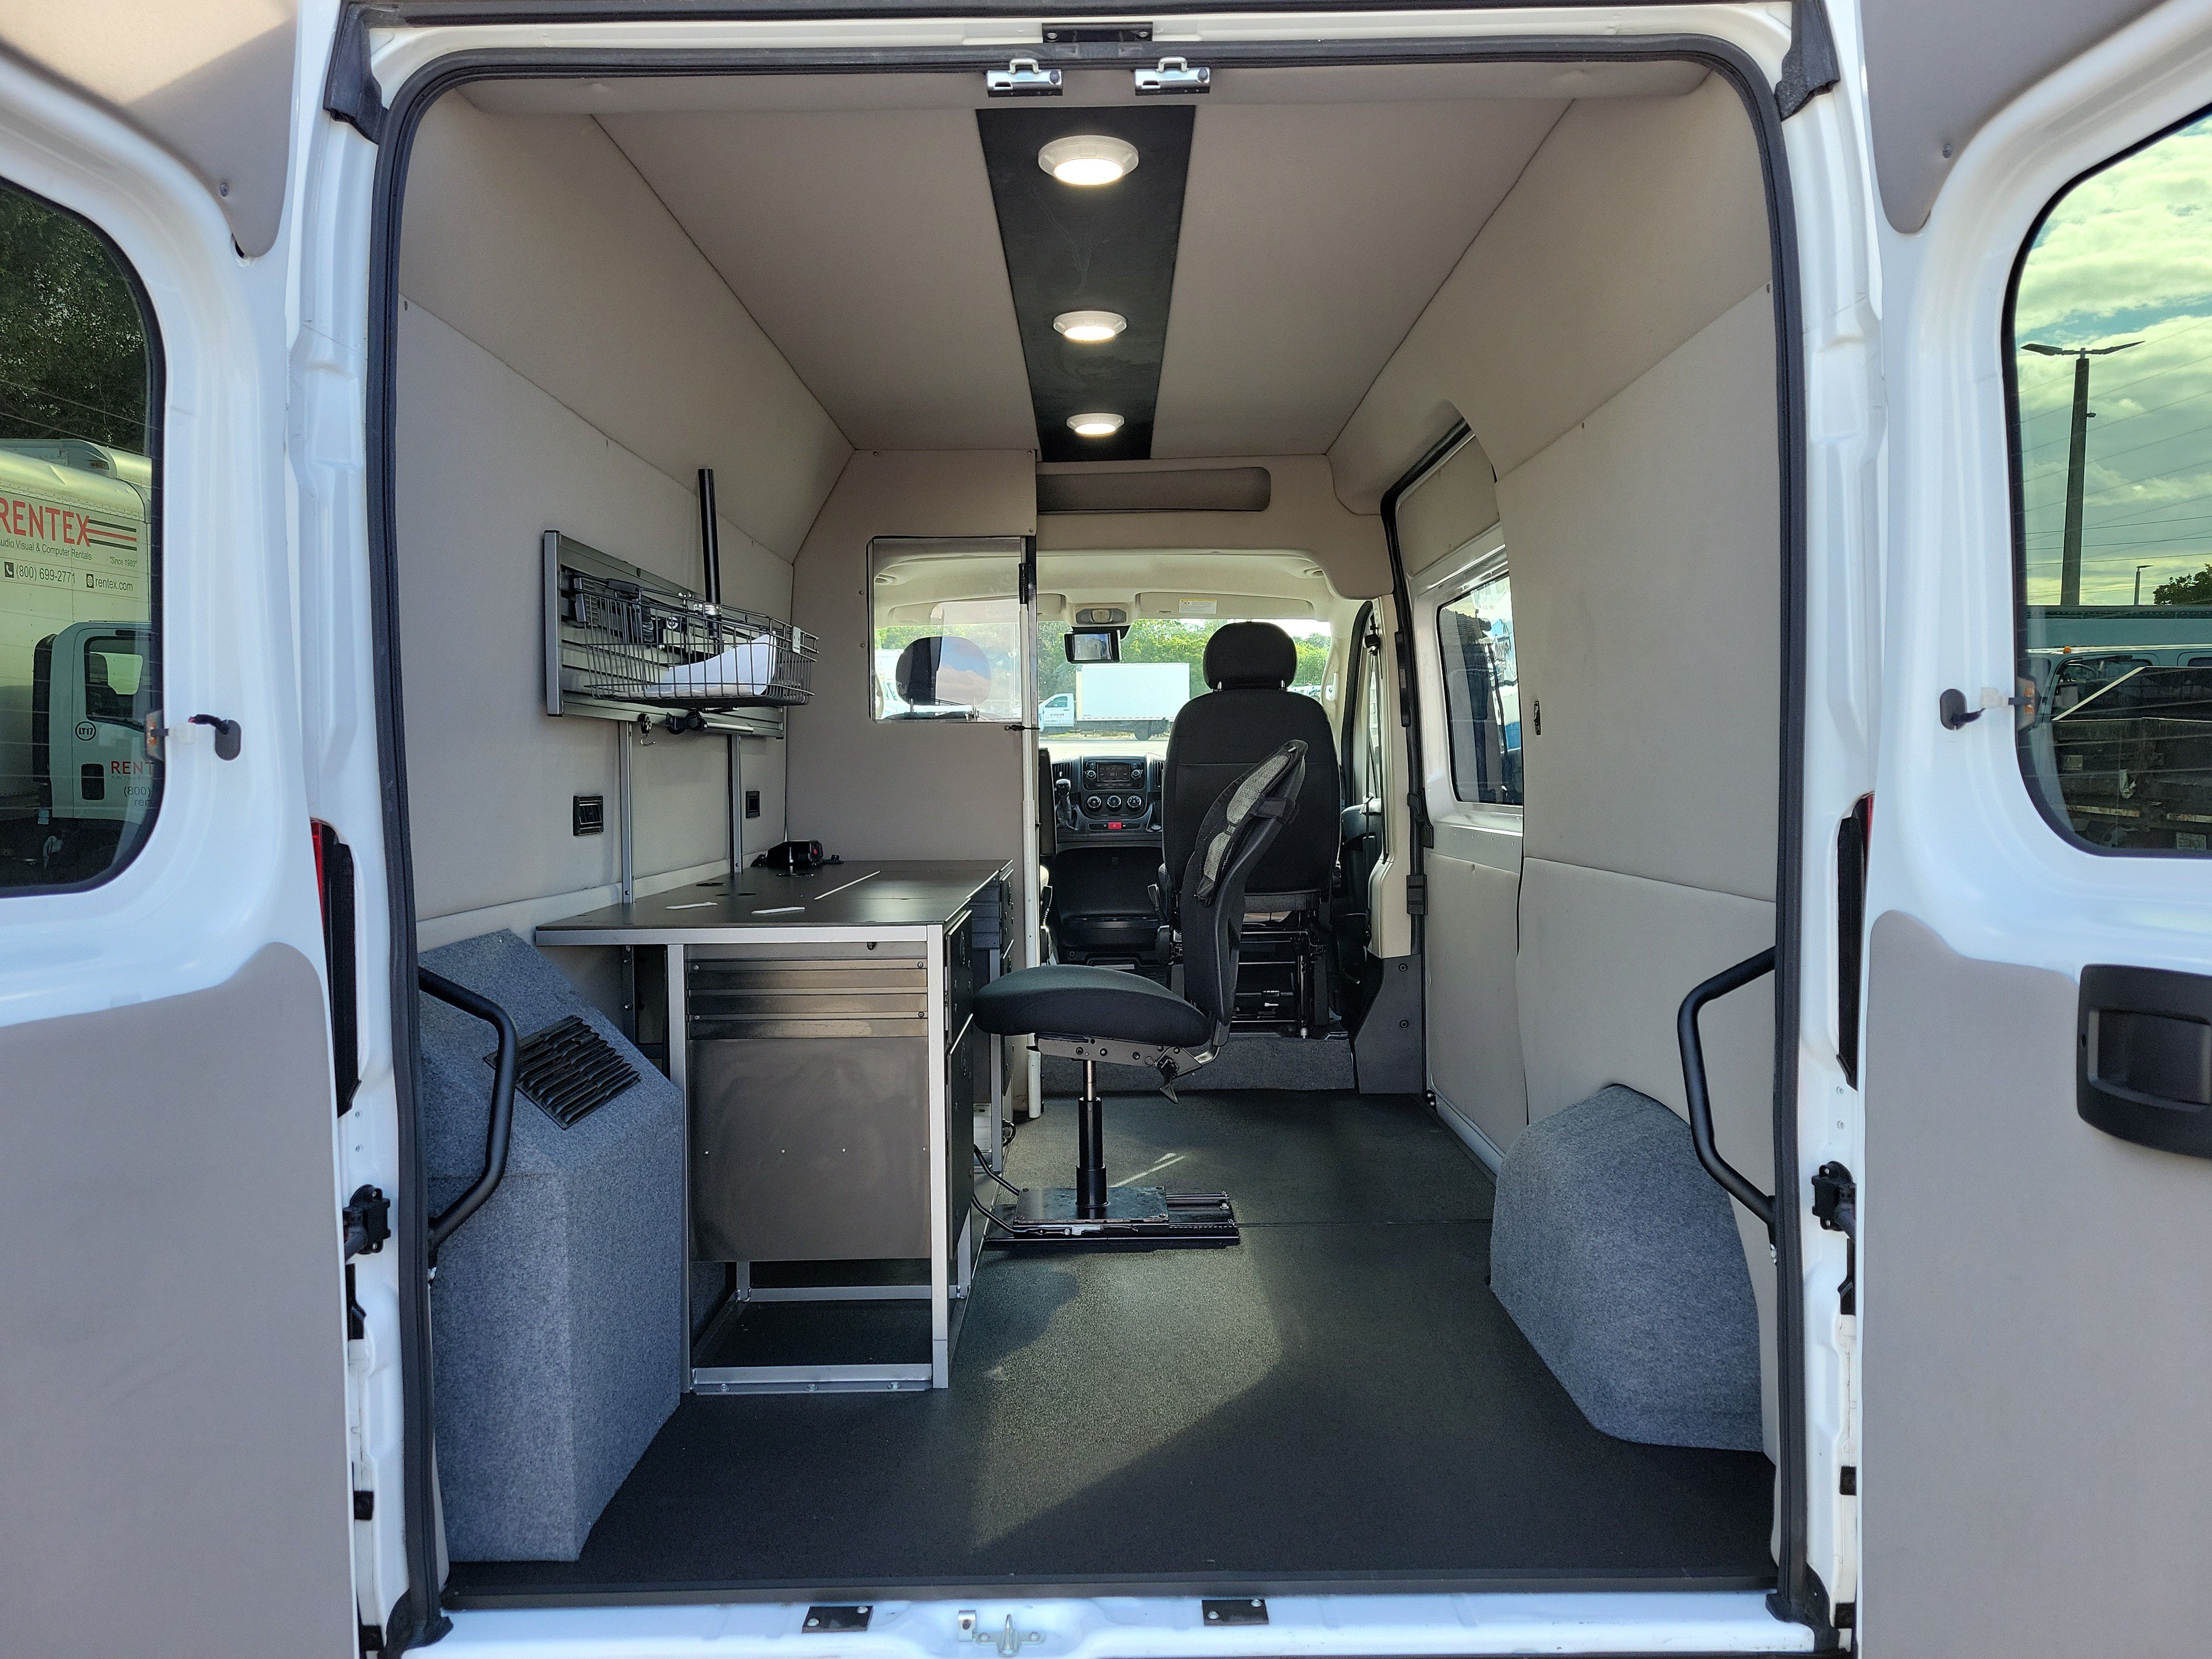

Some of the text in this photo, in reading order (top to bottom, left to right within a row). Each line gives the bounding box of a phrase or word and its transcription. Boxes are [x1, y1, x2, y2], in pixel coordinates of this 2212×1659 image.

[0, 497, 91, 548] RENTEX
[15, 539, 34, 551] Visual
[36, 543, 41, 552] &
[42, 544, 70, 557] Computer
[71, 549, 92, 560] Rentals
[16, 565, 76, 584] (800) 699-2771
[95, 577, 133, 591] rentex.com
[124, 786, 151, 798] (800)
